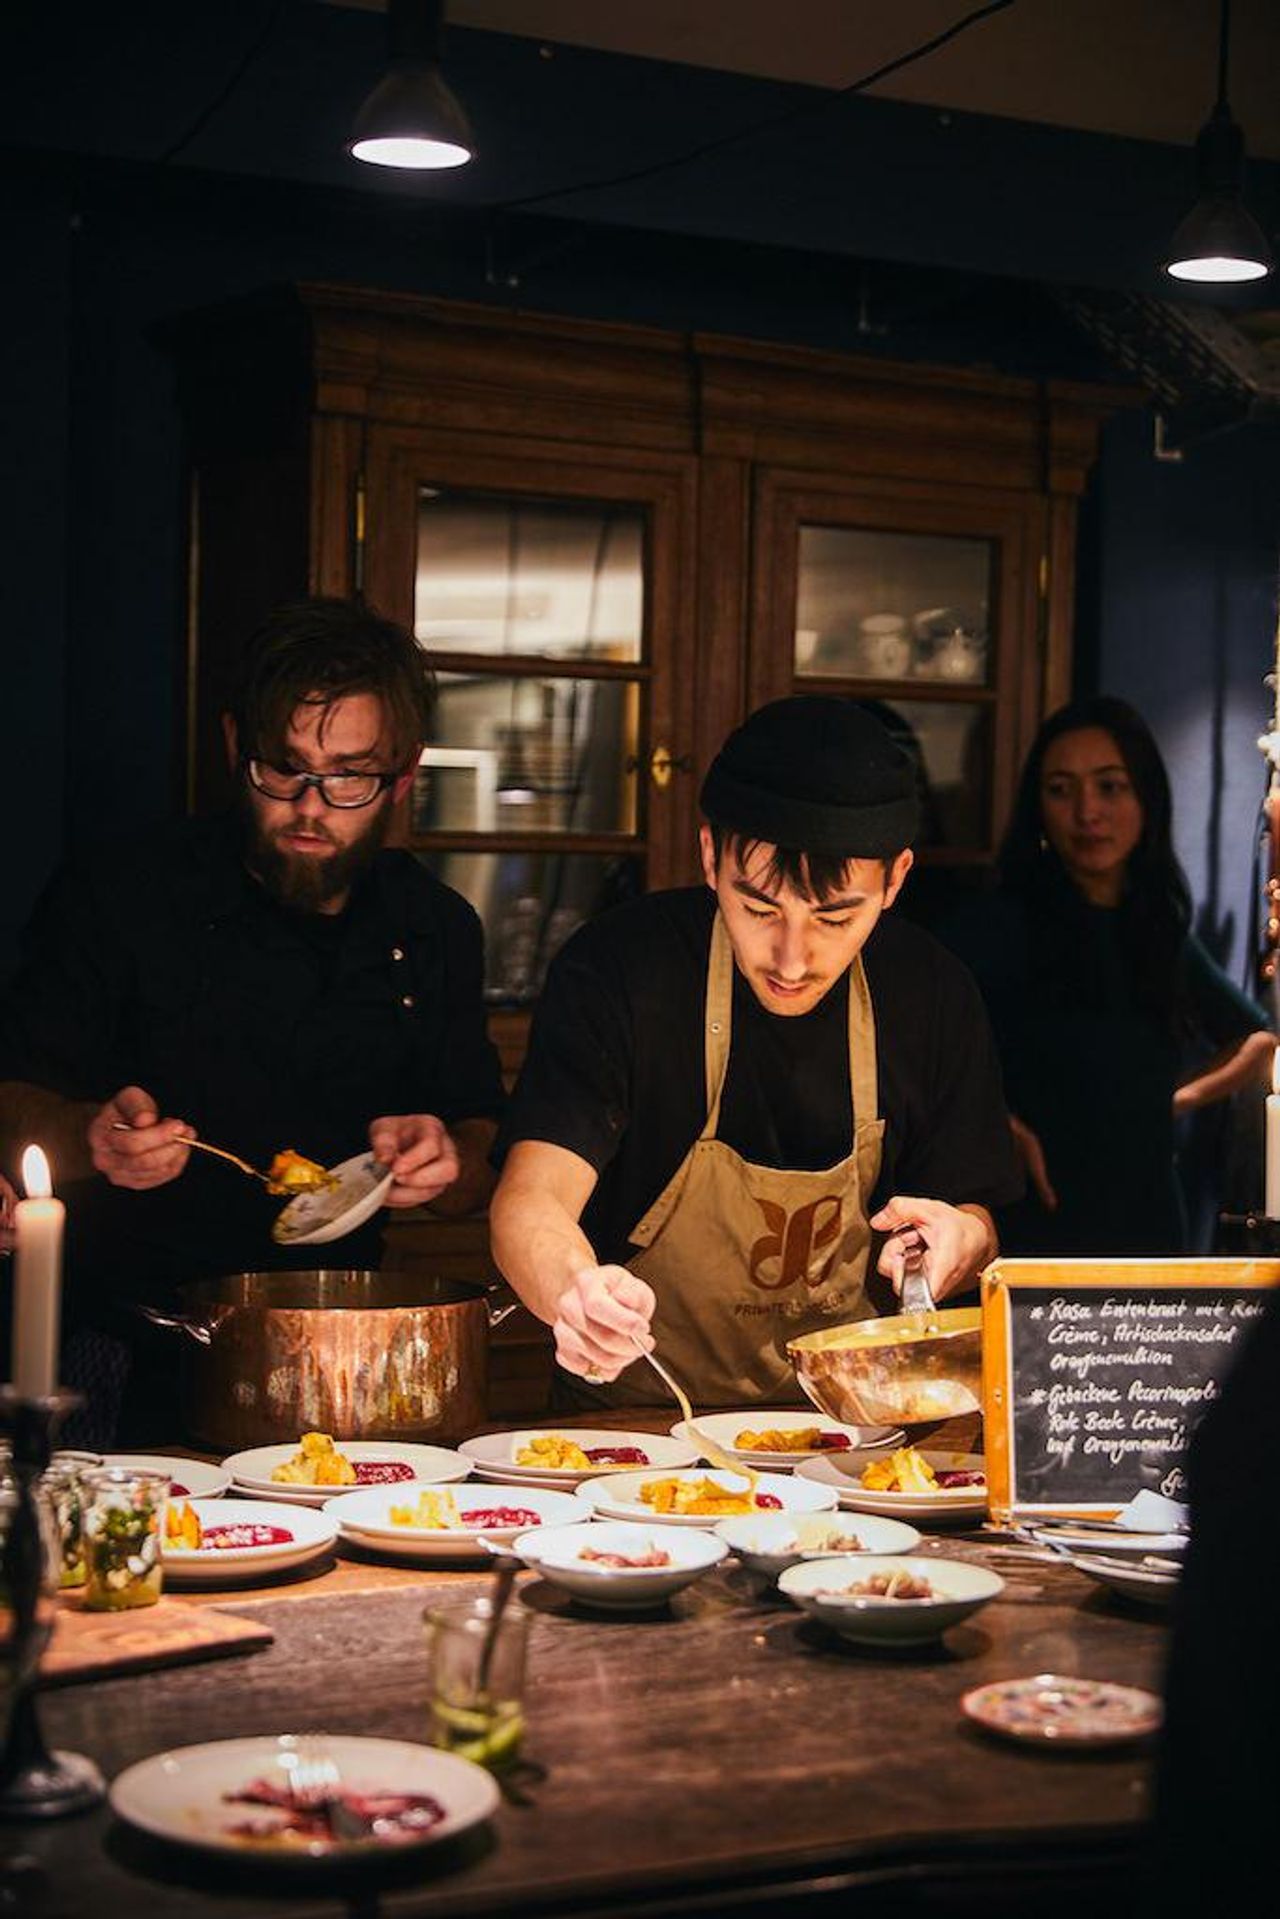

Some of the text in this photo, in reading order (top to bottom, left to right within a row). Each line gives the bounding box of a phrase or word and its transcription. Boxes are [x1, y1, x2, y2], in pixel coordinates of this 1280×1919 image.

[1048, 1297, 1093, 1321] Rosa
[1194, 1299, 1226, 1318] mit
[1047, 1383, 1121, 1416] Gebackene
